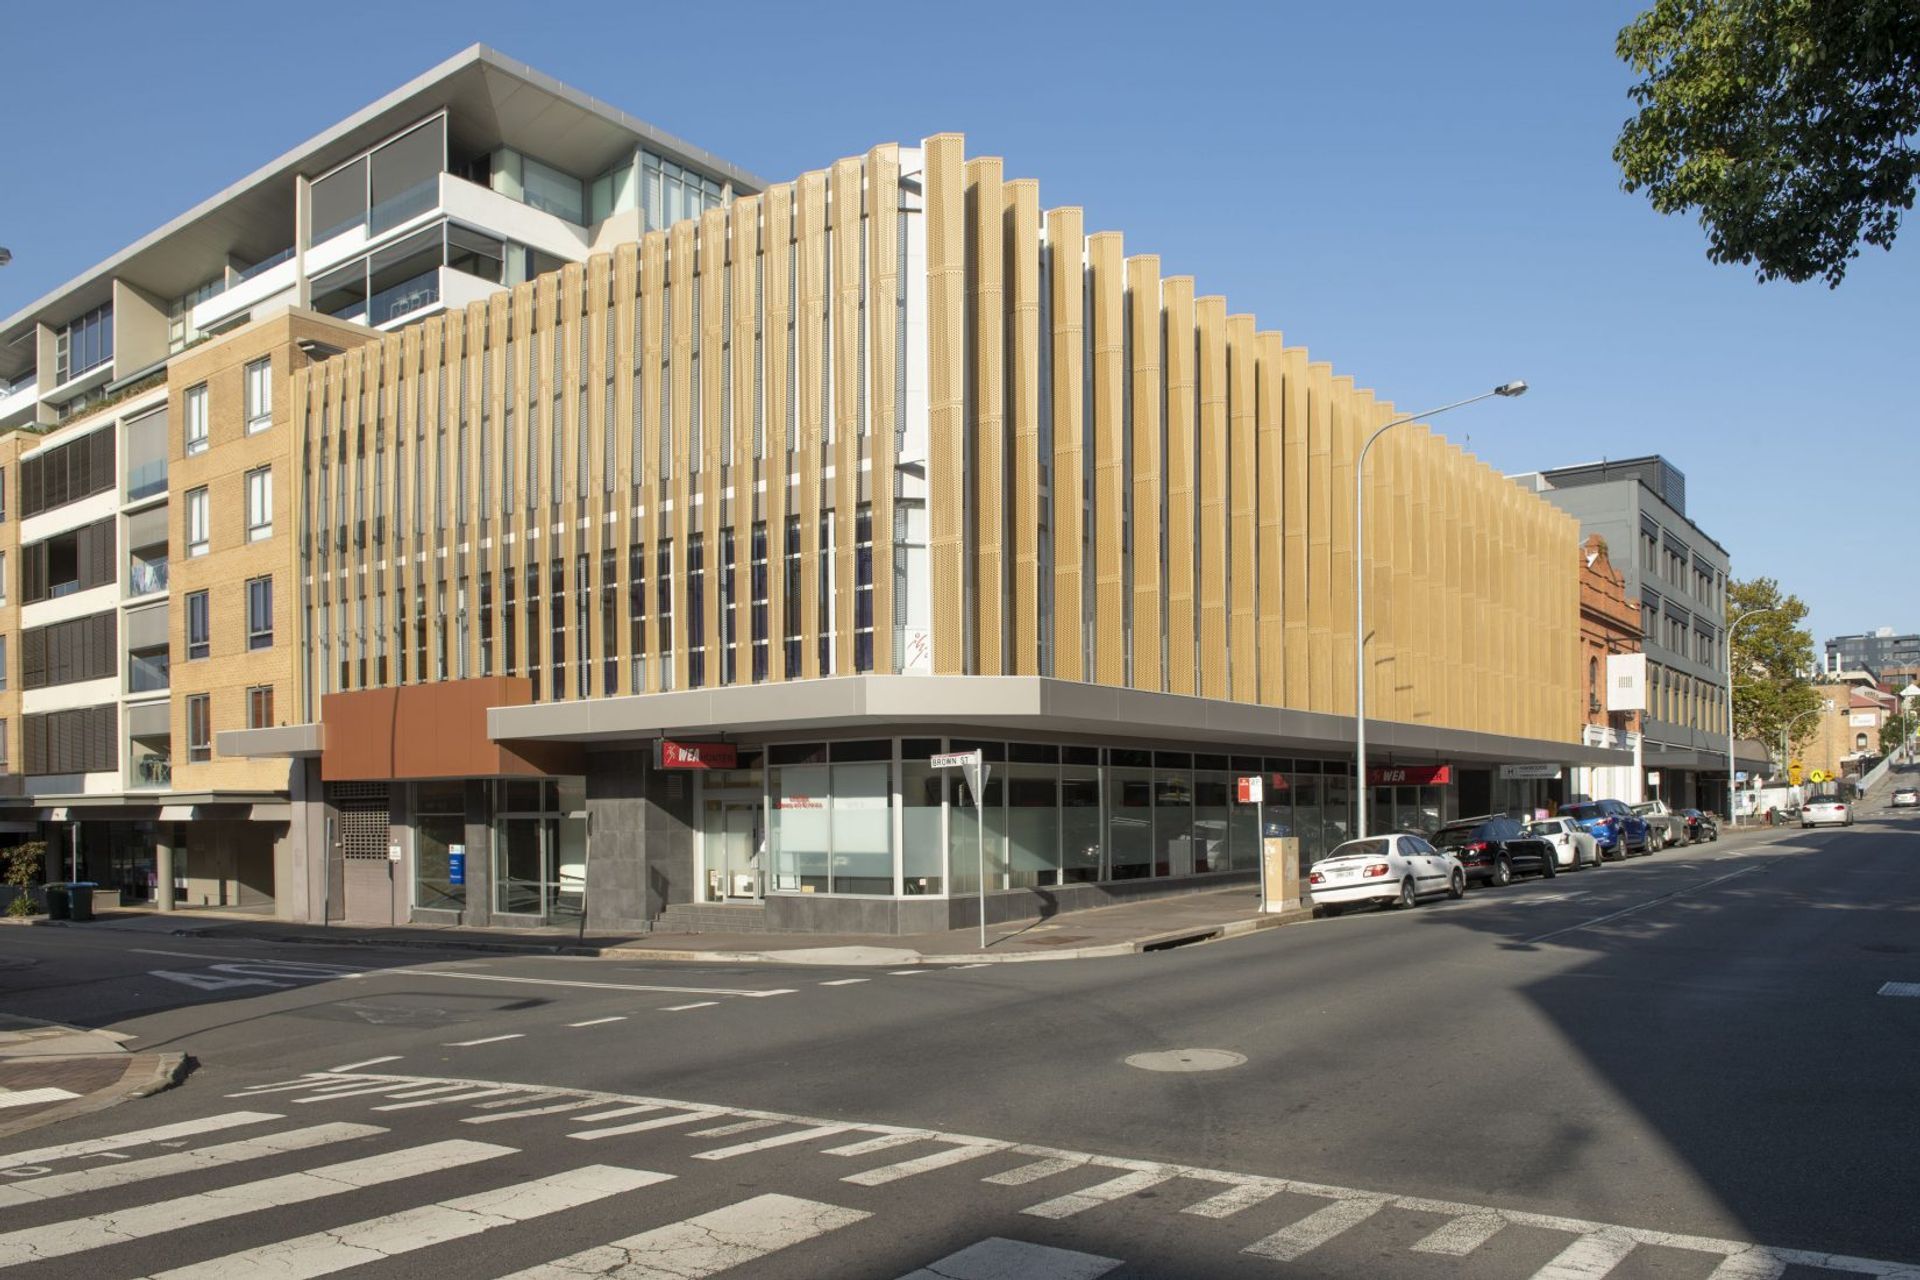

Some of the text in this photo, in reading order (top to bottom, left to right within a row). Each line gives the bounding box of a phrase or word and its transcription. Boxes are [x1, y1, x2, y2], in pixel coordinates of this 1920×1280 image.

[678, 748, 700, 762] WEA
[932, 756, 969, 767] BROWN ST
[1383, 769, 1406, 782] WEA
